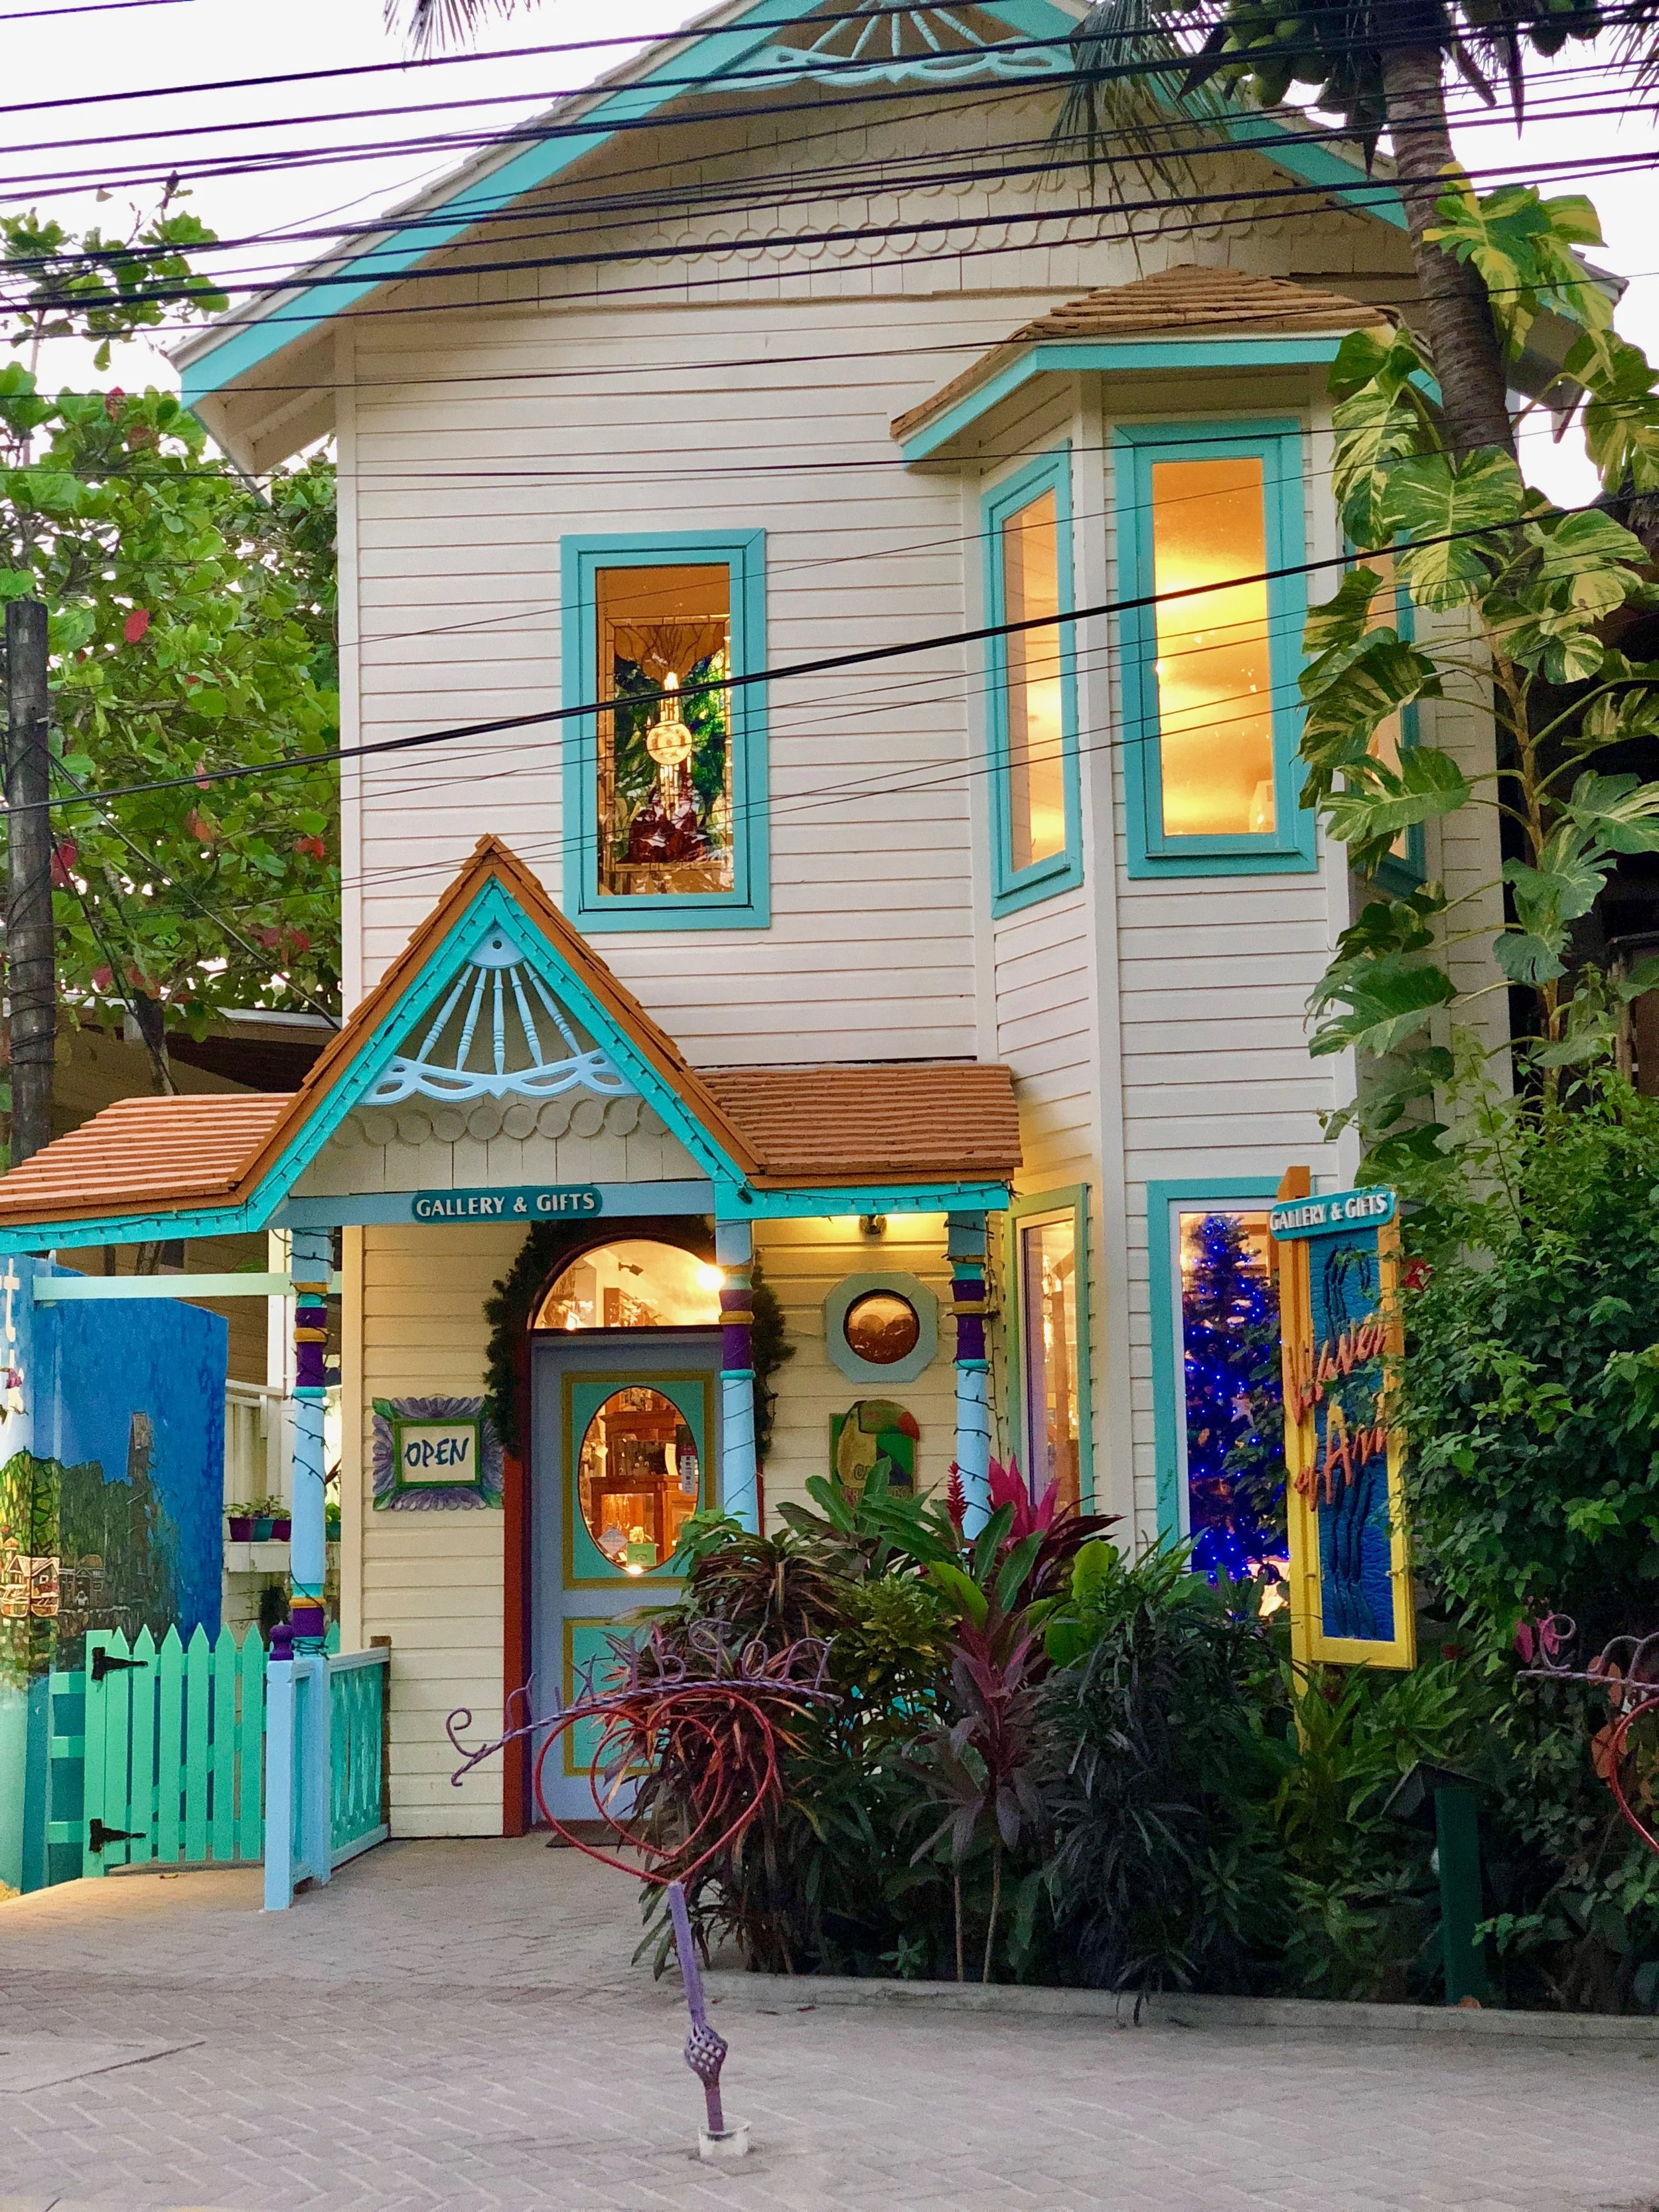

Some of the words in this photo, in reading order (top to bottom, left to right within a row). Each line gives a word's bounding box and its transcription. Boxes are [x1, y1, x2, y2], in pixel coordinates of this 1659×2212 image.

[416, 1196, 505, 1217] GALLERY
[513, 1196, 528, 1213] &
[536, 1192, 595, 1212] GIFTS
[1269, 1204, 1327, 1231] GALLERY
[1330, 1201, 1343, 1220] &
[1344, 1193, 1388, 1218] GIFTS
[404, 1437, 469, 1467] OPEN
